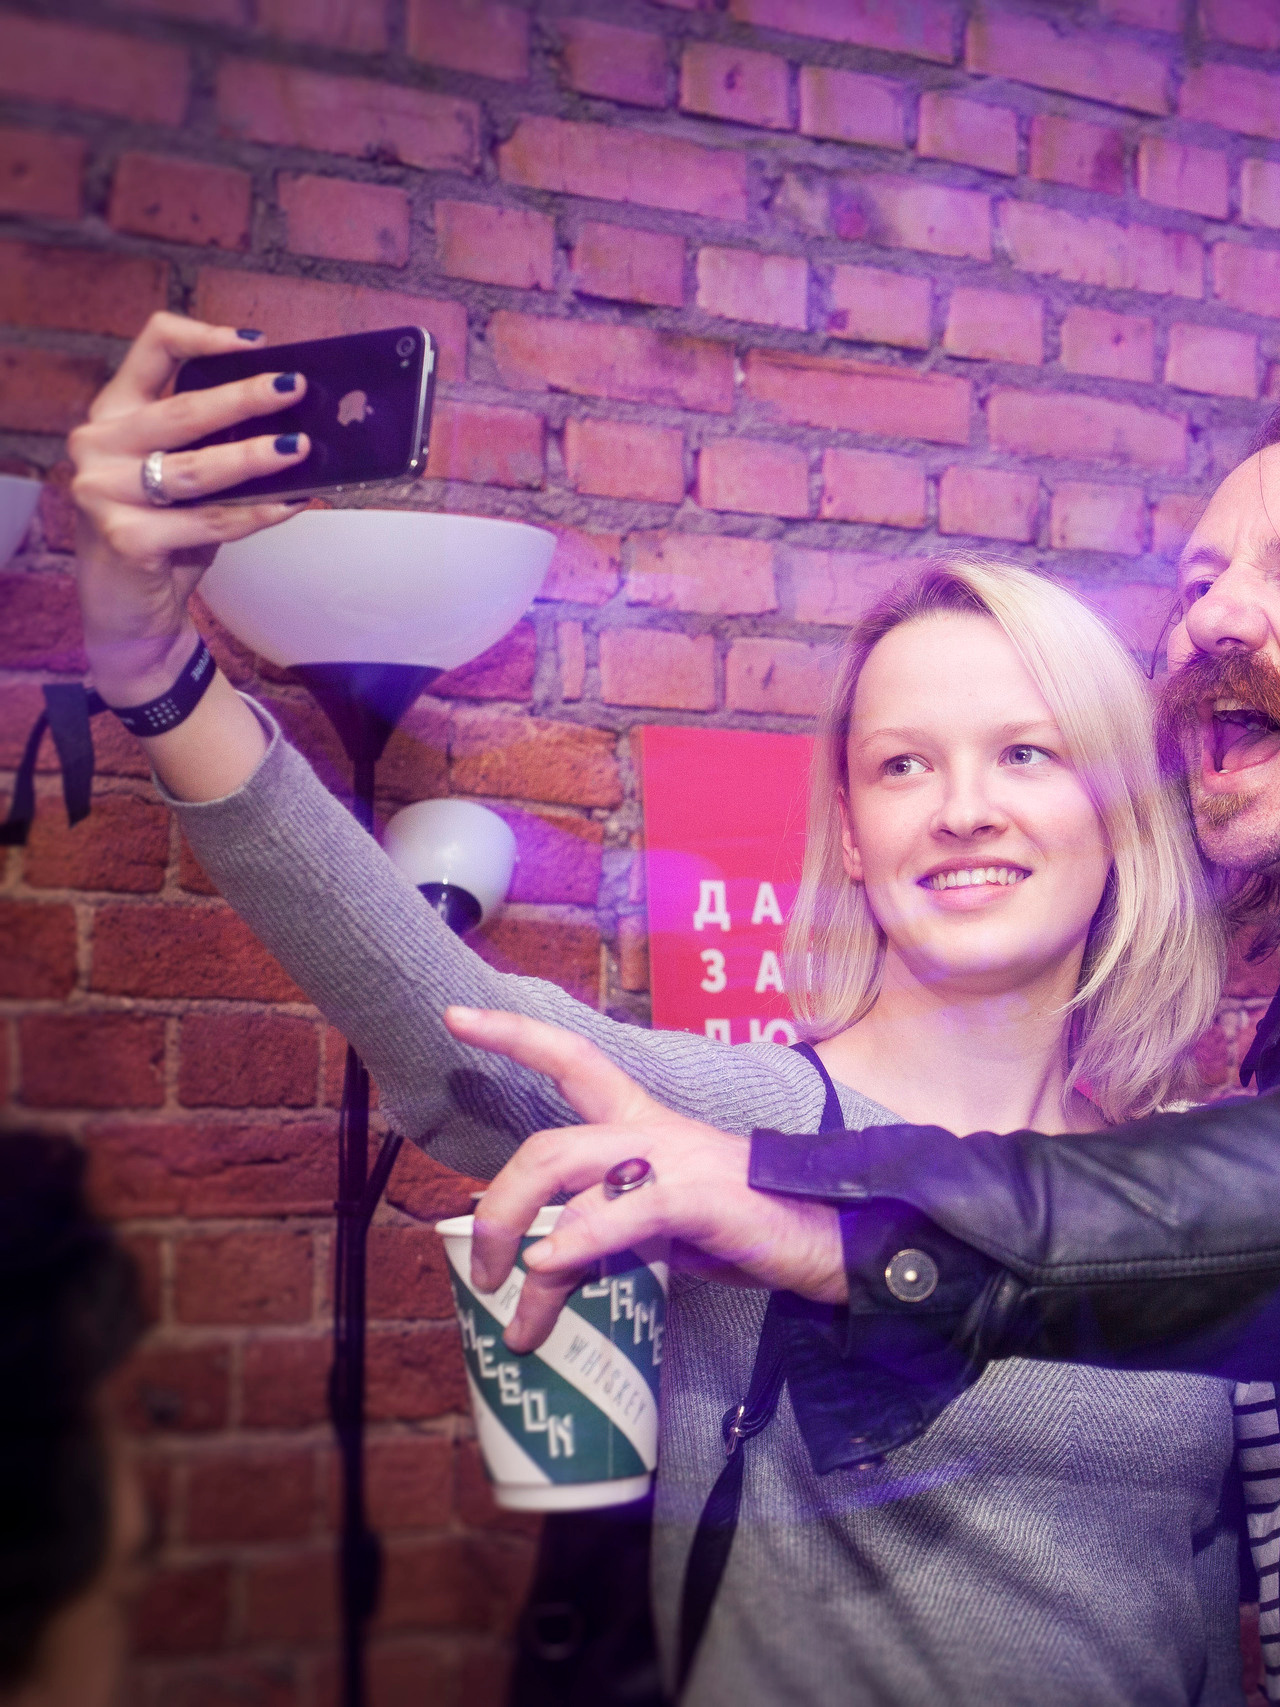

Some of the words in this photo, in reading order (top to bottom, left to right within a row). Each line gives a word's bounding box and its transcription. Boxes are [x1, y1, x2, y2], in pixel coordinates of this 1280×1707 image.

[700, 948, 812, 993] ЗА
[454, 1294, 575, 1458] MESON
[563, 1334, 647, 1425] WHISKEY
